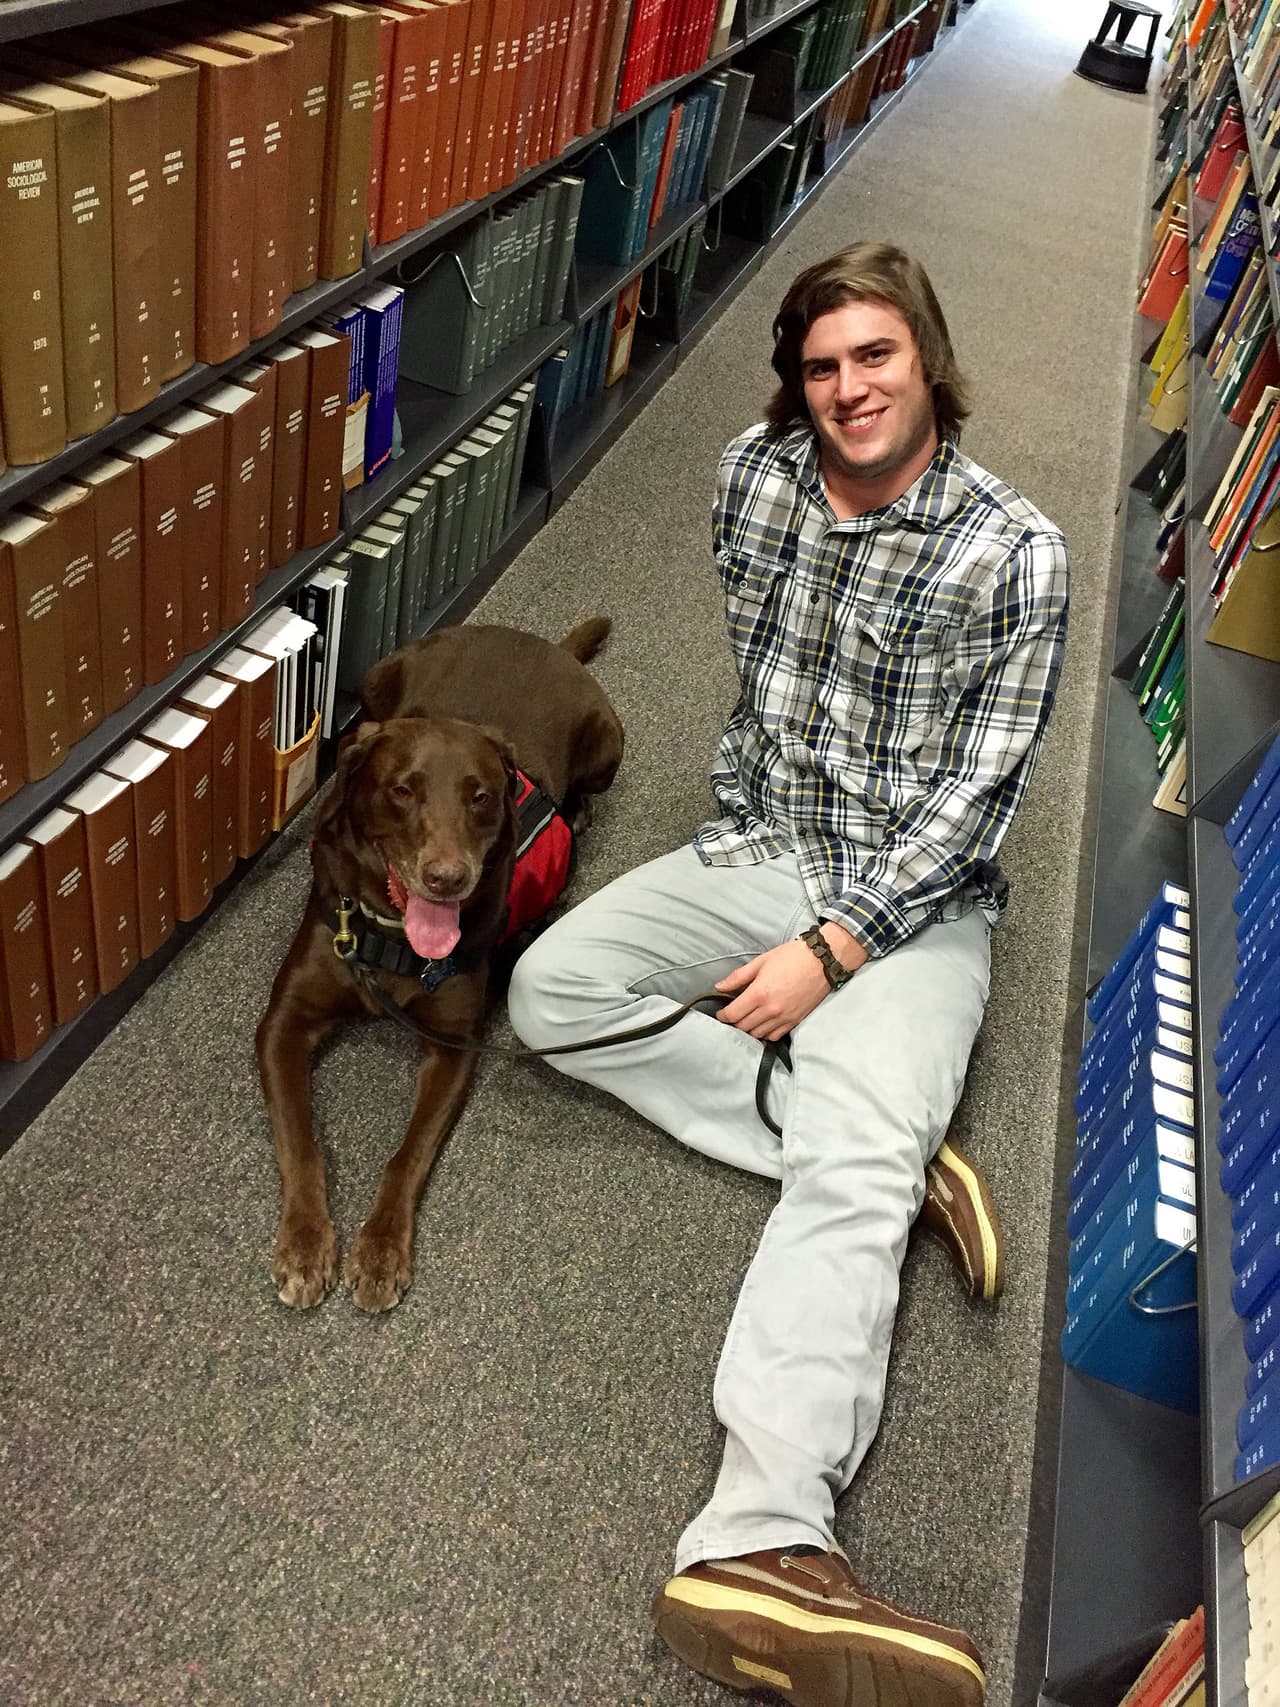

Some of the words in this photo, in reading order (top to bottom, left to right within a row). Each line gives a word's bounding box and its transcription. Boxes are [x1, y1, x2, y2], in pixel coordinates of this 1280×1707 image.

[12, 158, 43, 174] AMERICAN
[7, 171, 48, 188] SOCIOLOGICAL
[18, 186, 41, 200] REVIEW
[33, 289, 41, 301] 43
[33, 337, 47, 350] 1978
